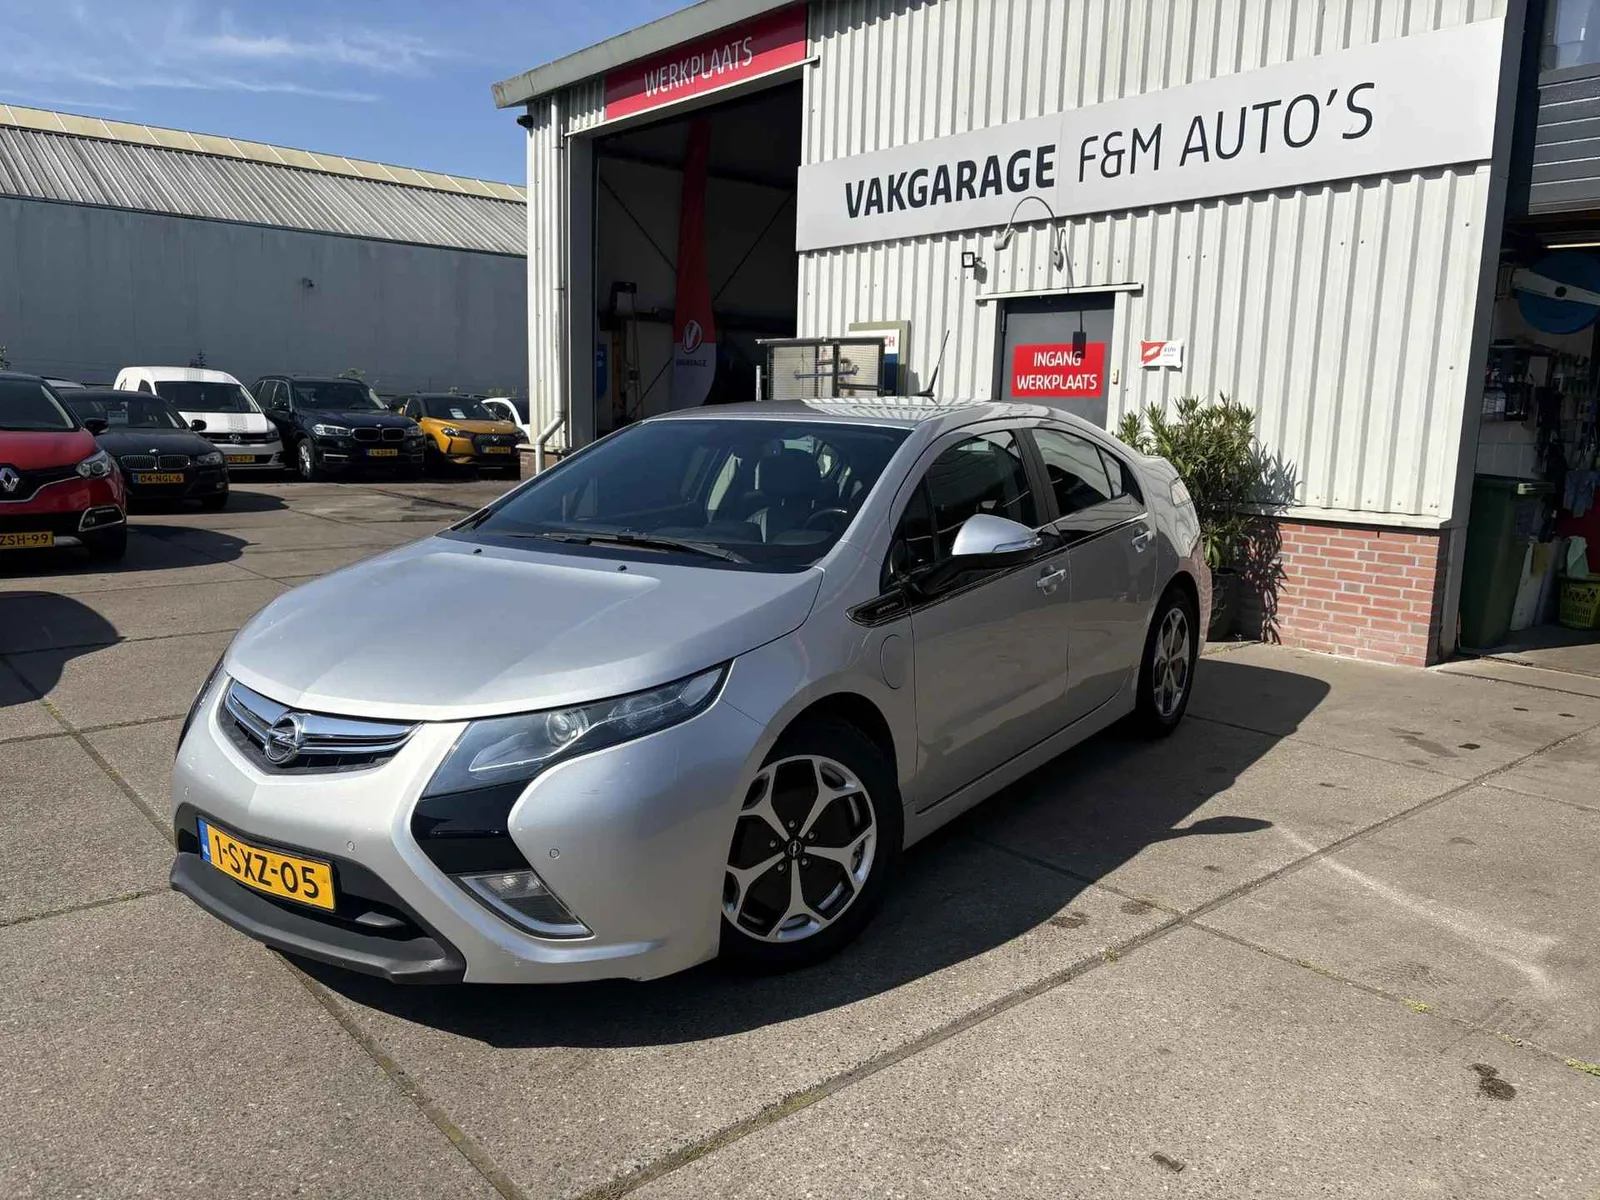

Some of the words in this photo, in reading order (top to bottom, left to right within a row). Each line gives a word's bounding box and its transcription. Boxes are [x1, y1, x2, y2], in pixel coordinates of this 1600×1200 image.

[644, 36, 753, 98] WERKPLAATS
[844, 143, 1057, 219] VAKGARAGE
[1078, 123, 1163, 183] F&M
[1180, 82, 1376, 168] AUTO'S
[1016, 373, 1098, 390] WERKPLAATS
[1033, 350, 1083, 367] INGANG
[214, 834, 320, 899] 1-SXZ-05
